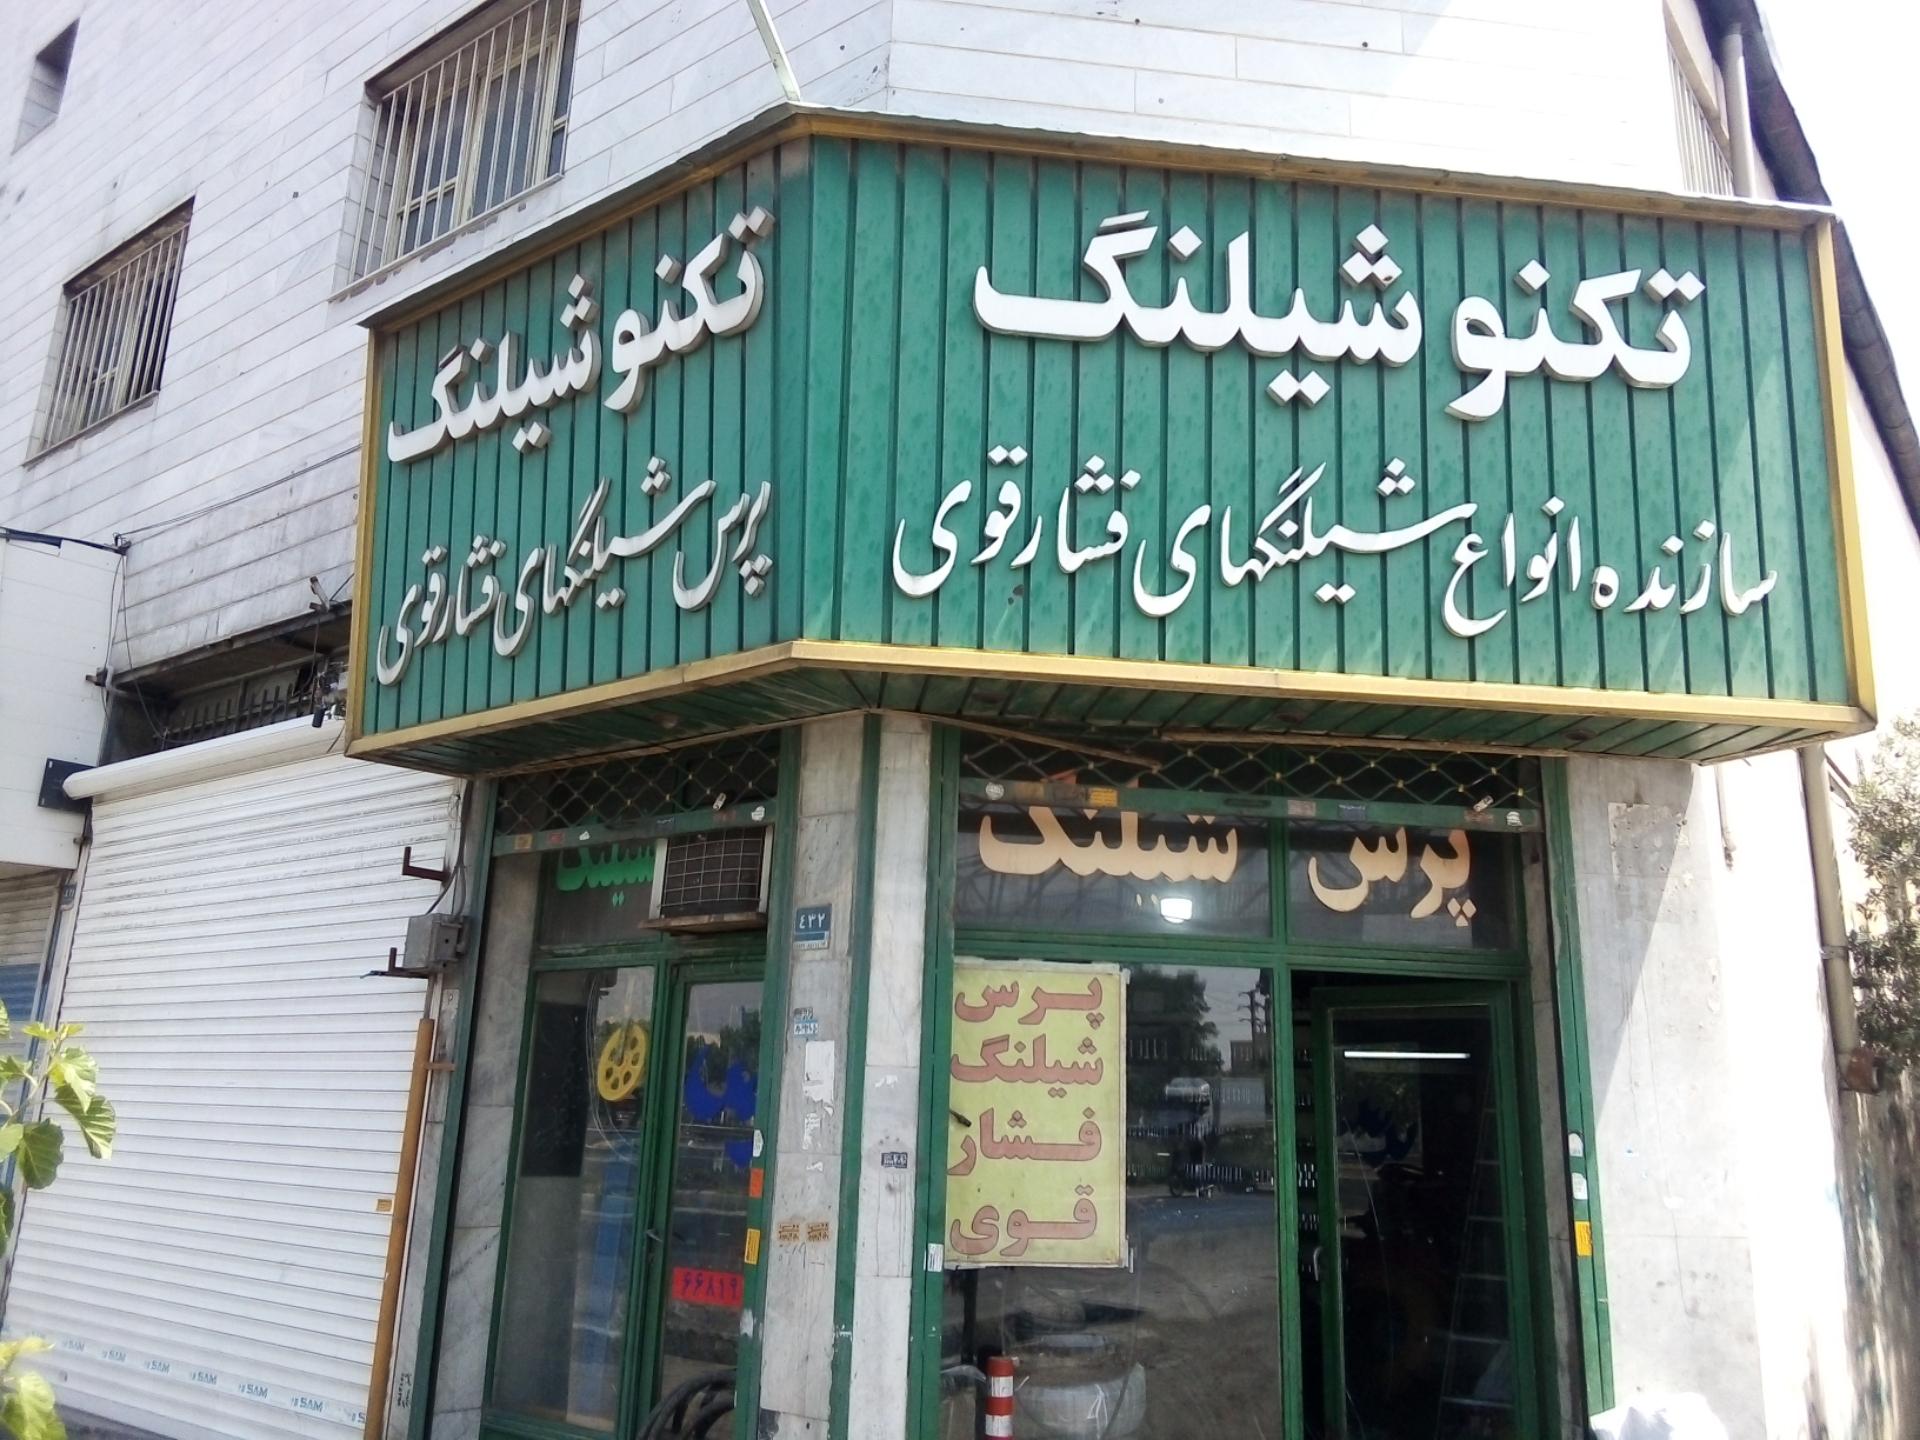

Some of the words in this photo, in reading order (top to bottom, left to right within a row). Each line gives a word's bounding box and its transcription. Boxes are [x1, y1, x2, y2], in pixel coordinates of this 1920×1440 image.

[973, 210, 1422, 407] شیلنگ
[387, 273, 601, 463] شیلنگ
[673, 481, 773, 611] پرس
[892, 445, 1028, 598] قوی
[1010, 455, 1141, 574] فشار
[1442, 496, 1582, 638] انواع
[1591, 520, 1778, 616] سازنده
[377, 545, 447, 686] قوی
[432, 535, 507, 643] فشار
[1308, 826, 1477, 927] پرس
[954, 977, 1104, 1029] پرس
[951, 1034, 1103, 1098] شیلنگ
[947, 1107, 1102, 1175] فشار
[950, 1185, 1097, 1256] قوی
